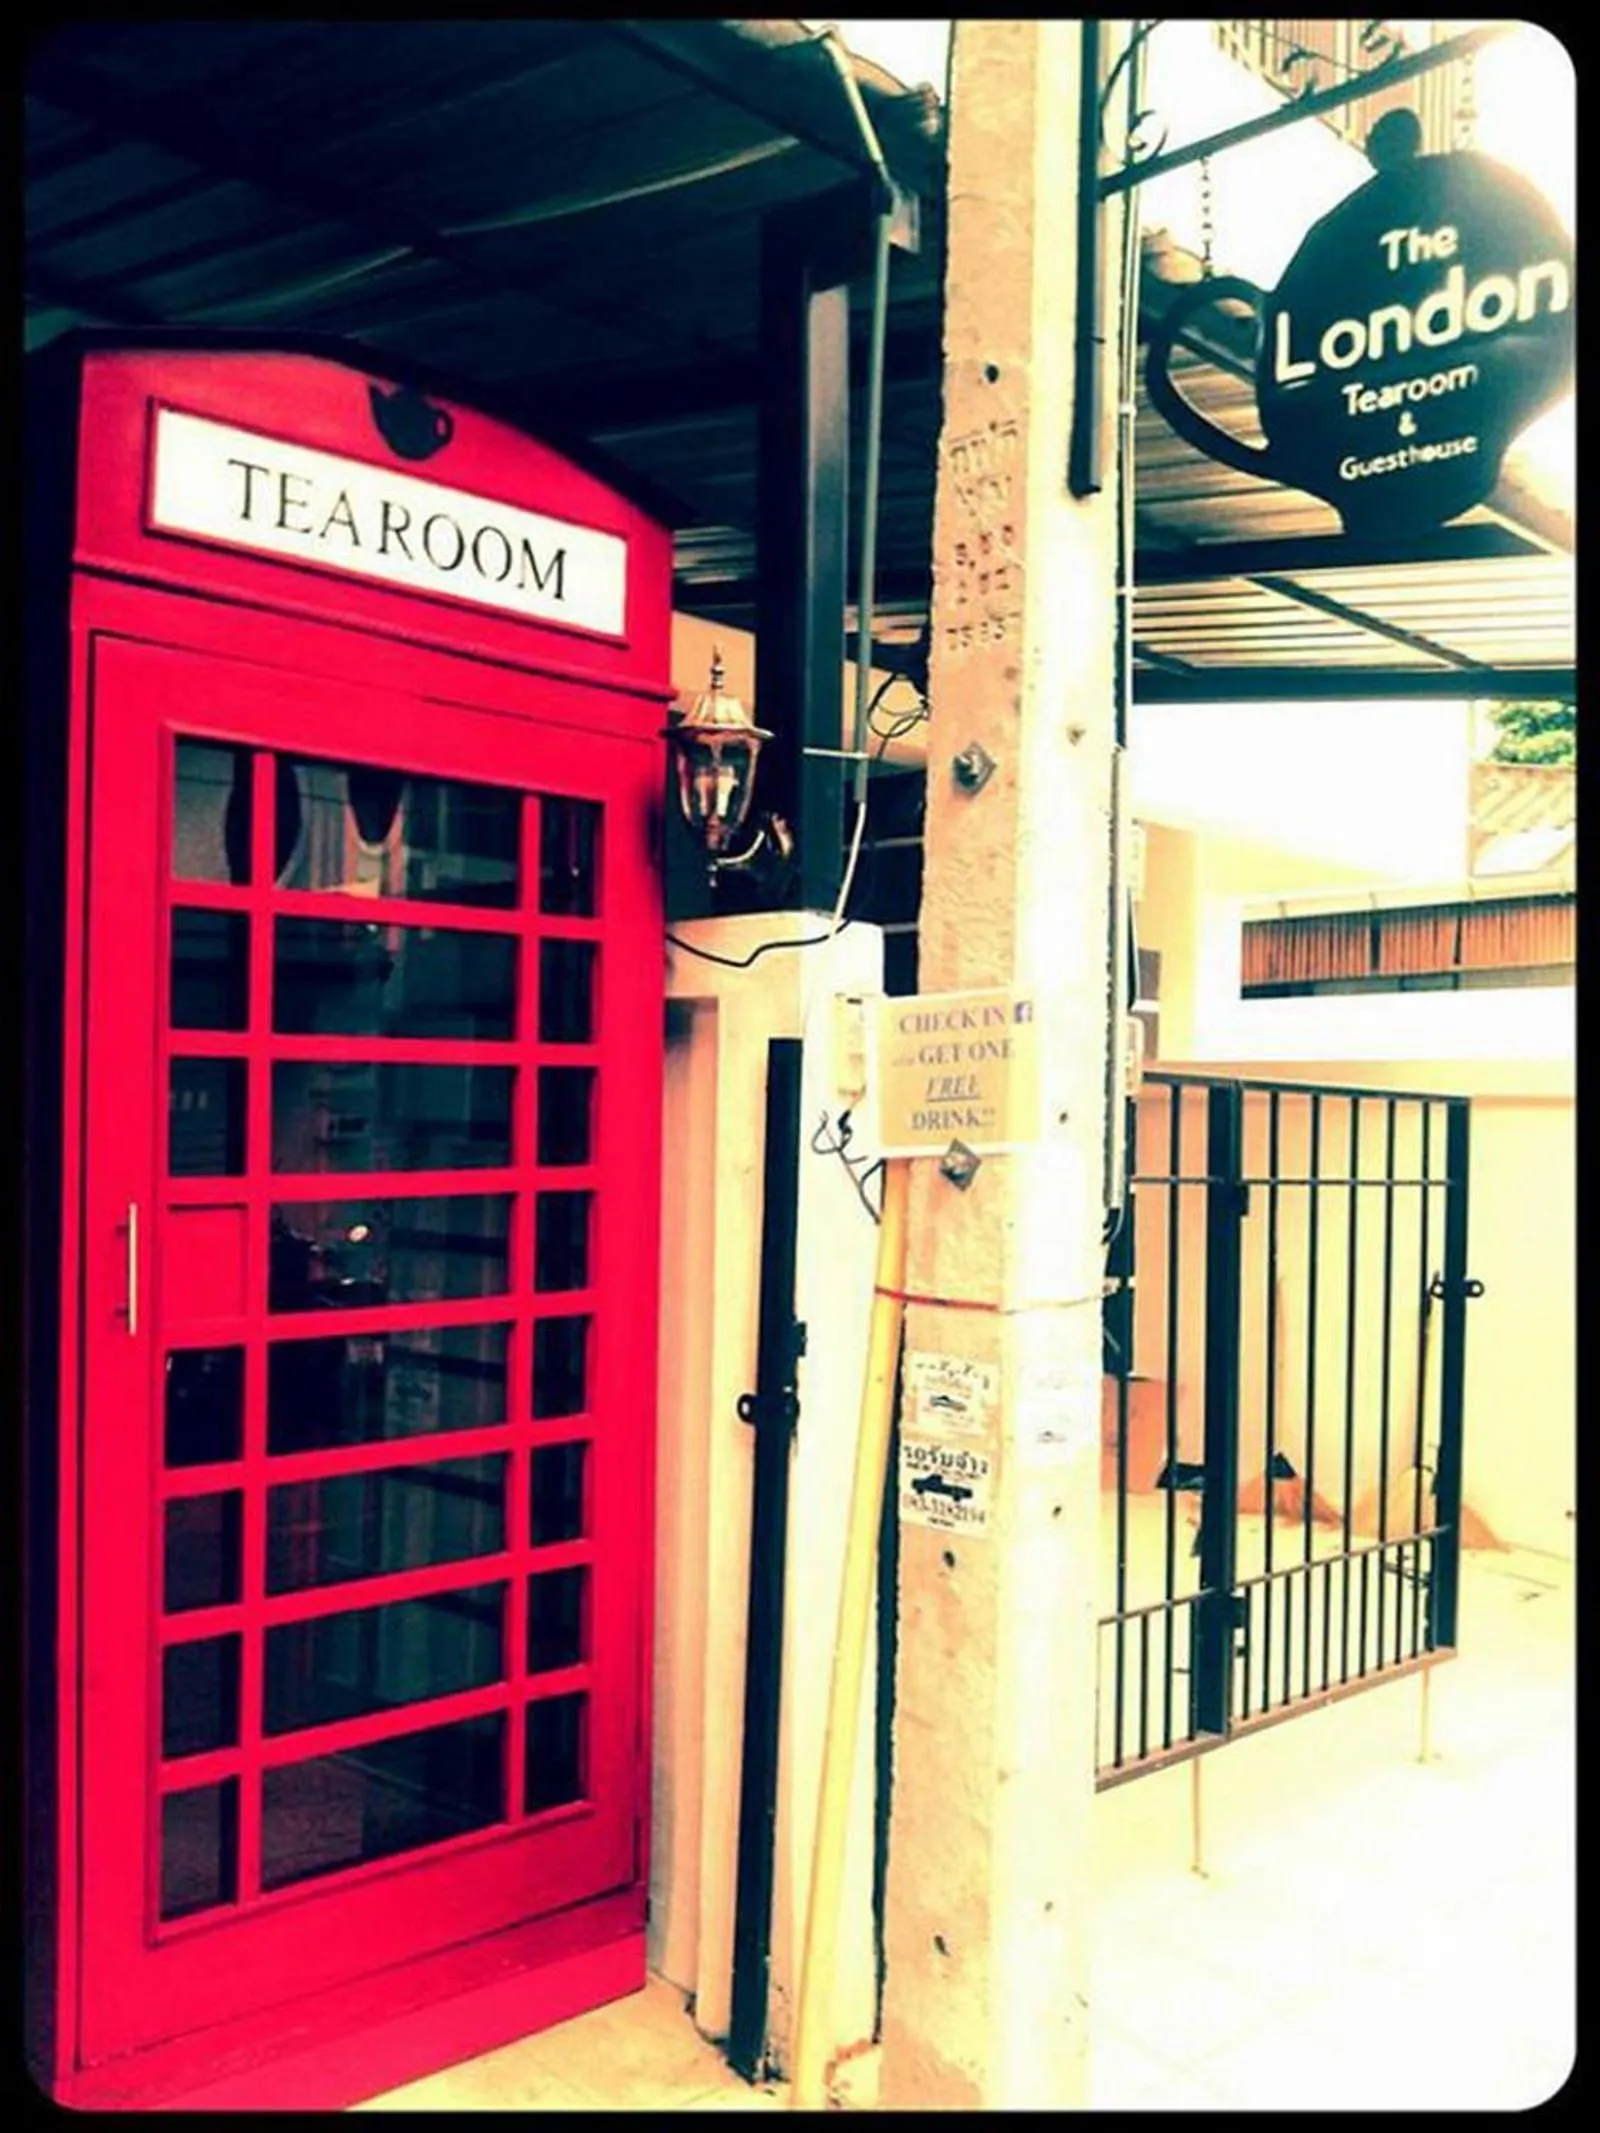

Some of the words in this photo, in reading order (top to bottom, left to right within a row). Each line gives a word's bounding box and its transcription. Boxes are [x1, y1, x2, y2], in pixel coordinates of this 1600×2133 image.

[1379, 225, 1459, 270] The
[1275, 260, 1570, 383] London
[1342, 364, 1478, 415] Tearoom
[1398, 412, 1417, 436] &
[1339, 436, 1478, 480] Guesthouse
[227, 459, 567, 600] TEAROOM
[899, 1008, 976, 1034] CHECK
[982, 1005, 1006, 1027] IN
[918, 1042, 964, 1066] GET
[968, 1038, 1016, 1062] ONE
[925, 1073, 983, 1101] FREE
